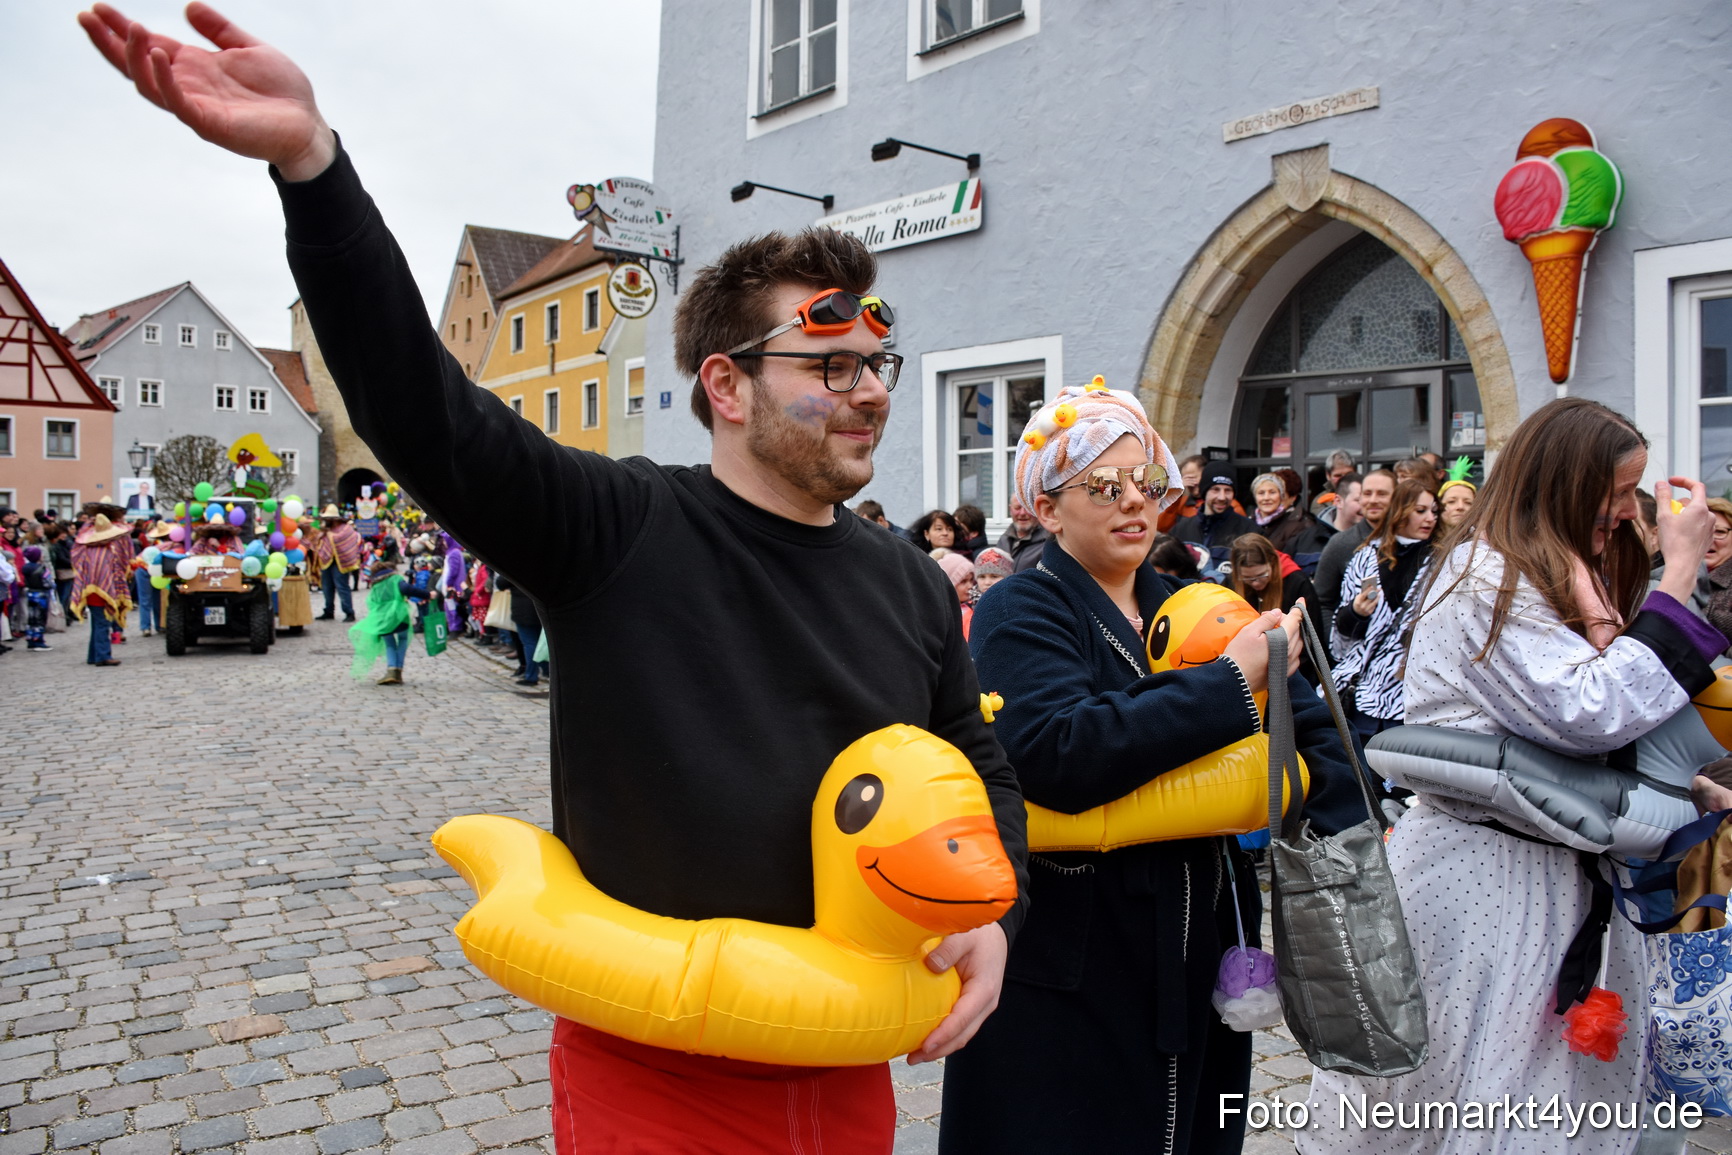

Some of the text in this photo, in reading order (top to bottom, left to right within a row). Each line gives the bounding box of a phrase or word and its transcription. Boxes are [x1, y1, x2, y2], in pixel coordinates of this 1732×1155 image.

[845, 212, 877, 224] Pizzeria
[913, 192, 947, 208] Eisdiele
[892, 216, 947, 240] Roma
